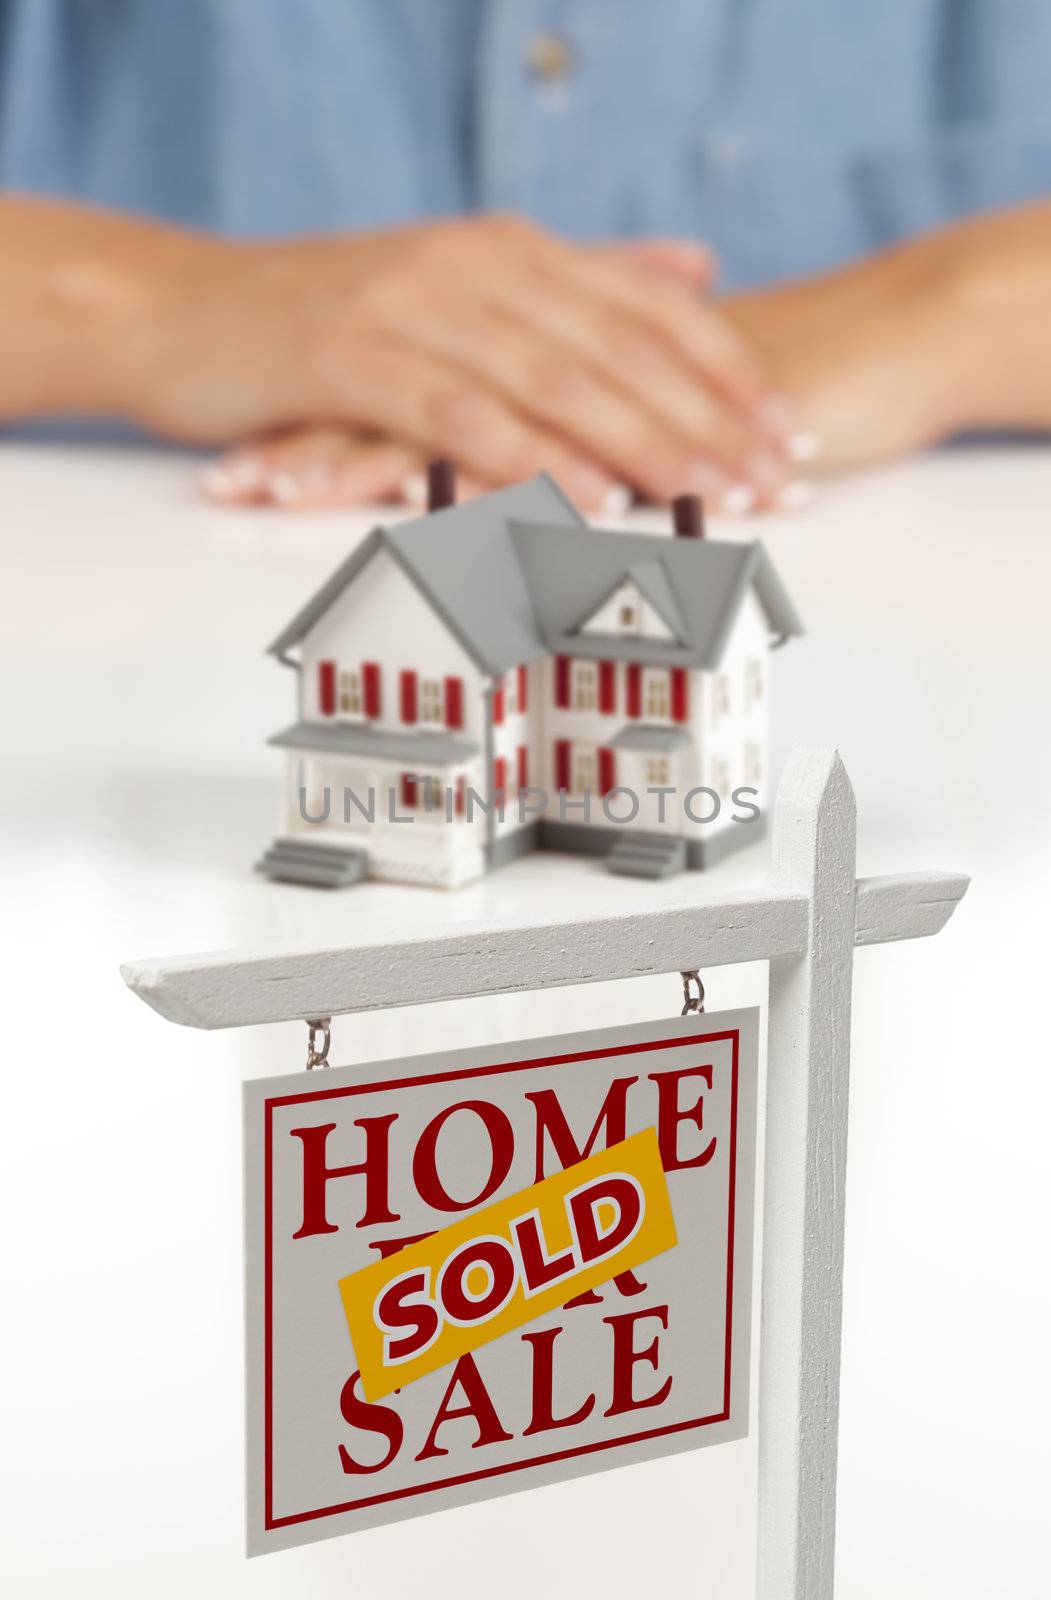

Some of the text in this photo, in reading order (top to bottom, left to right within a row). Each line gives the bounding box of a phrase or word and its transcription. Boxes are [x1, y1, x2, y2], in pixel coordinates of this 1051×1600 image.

[290, 1065, 717, 1240] HOME
[373, 1171, 646, 1367] SOLD
[338, 1305, 673, 1475] SALE
